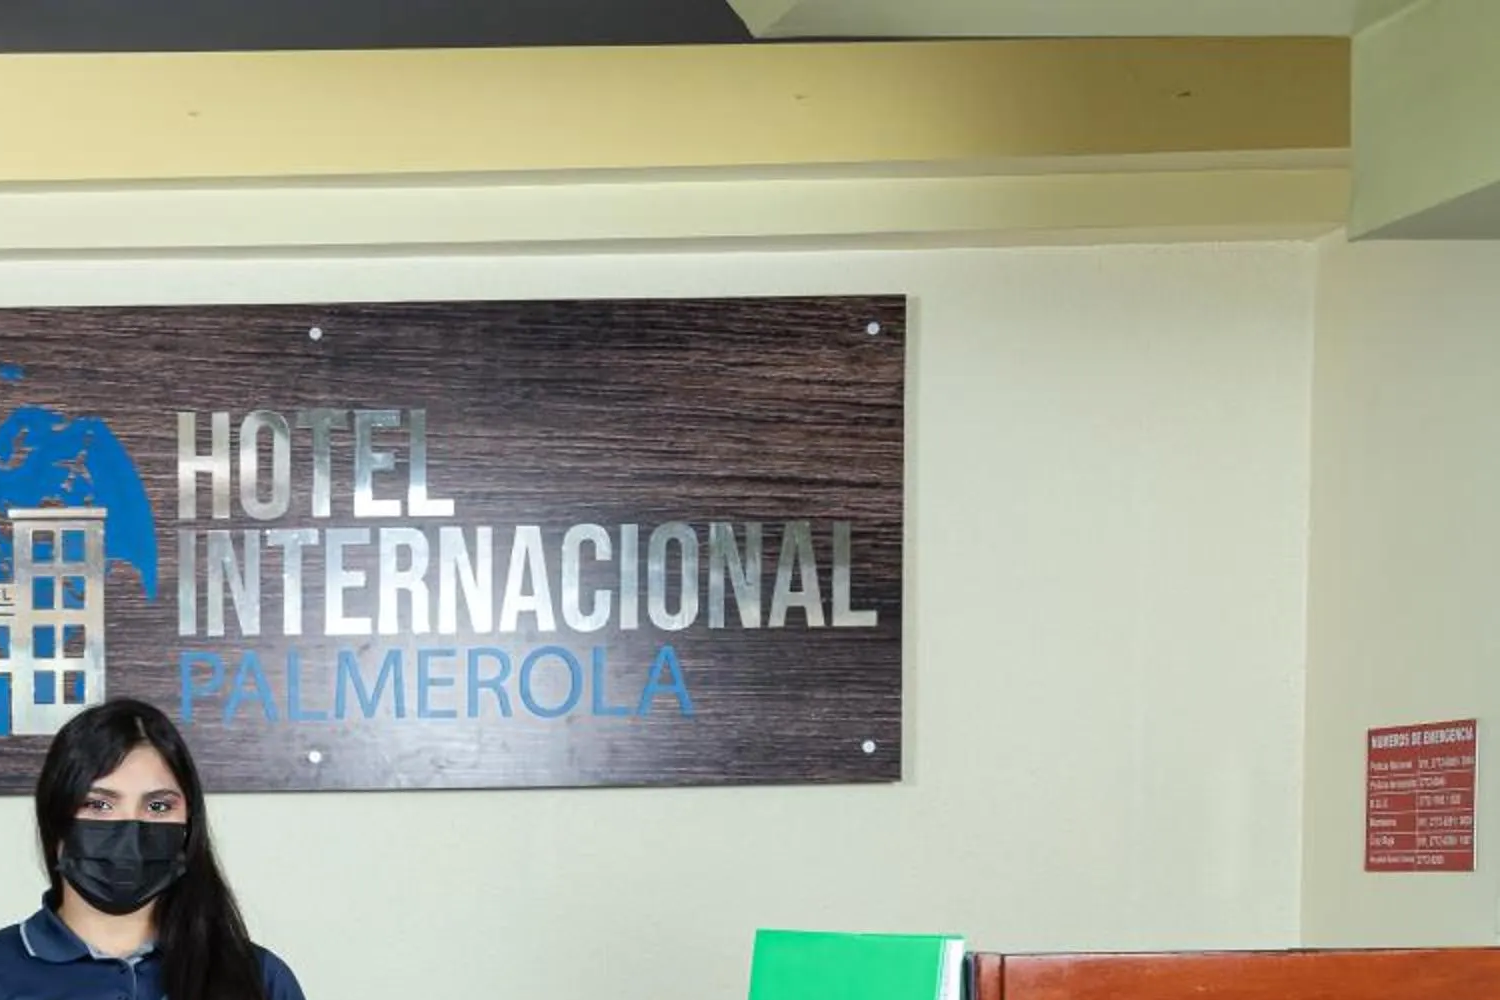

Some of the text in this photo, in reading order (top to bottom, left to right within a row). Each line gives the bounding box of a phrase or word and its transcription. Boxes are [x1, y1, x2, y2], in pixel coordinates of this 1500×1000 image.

[177, 408, 456, 519] HOTEL
[176, 521, 879, 637] INTERNACIONAL
[178, 643, 695, 726] PALMEROLA
